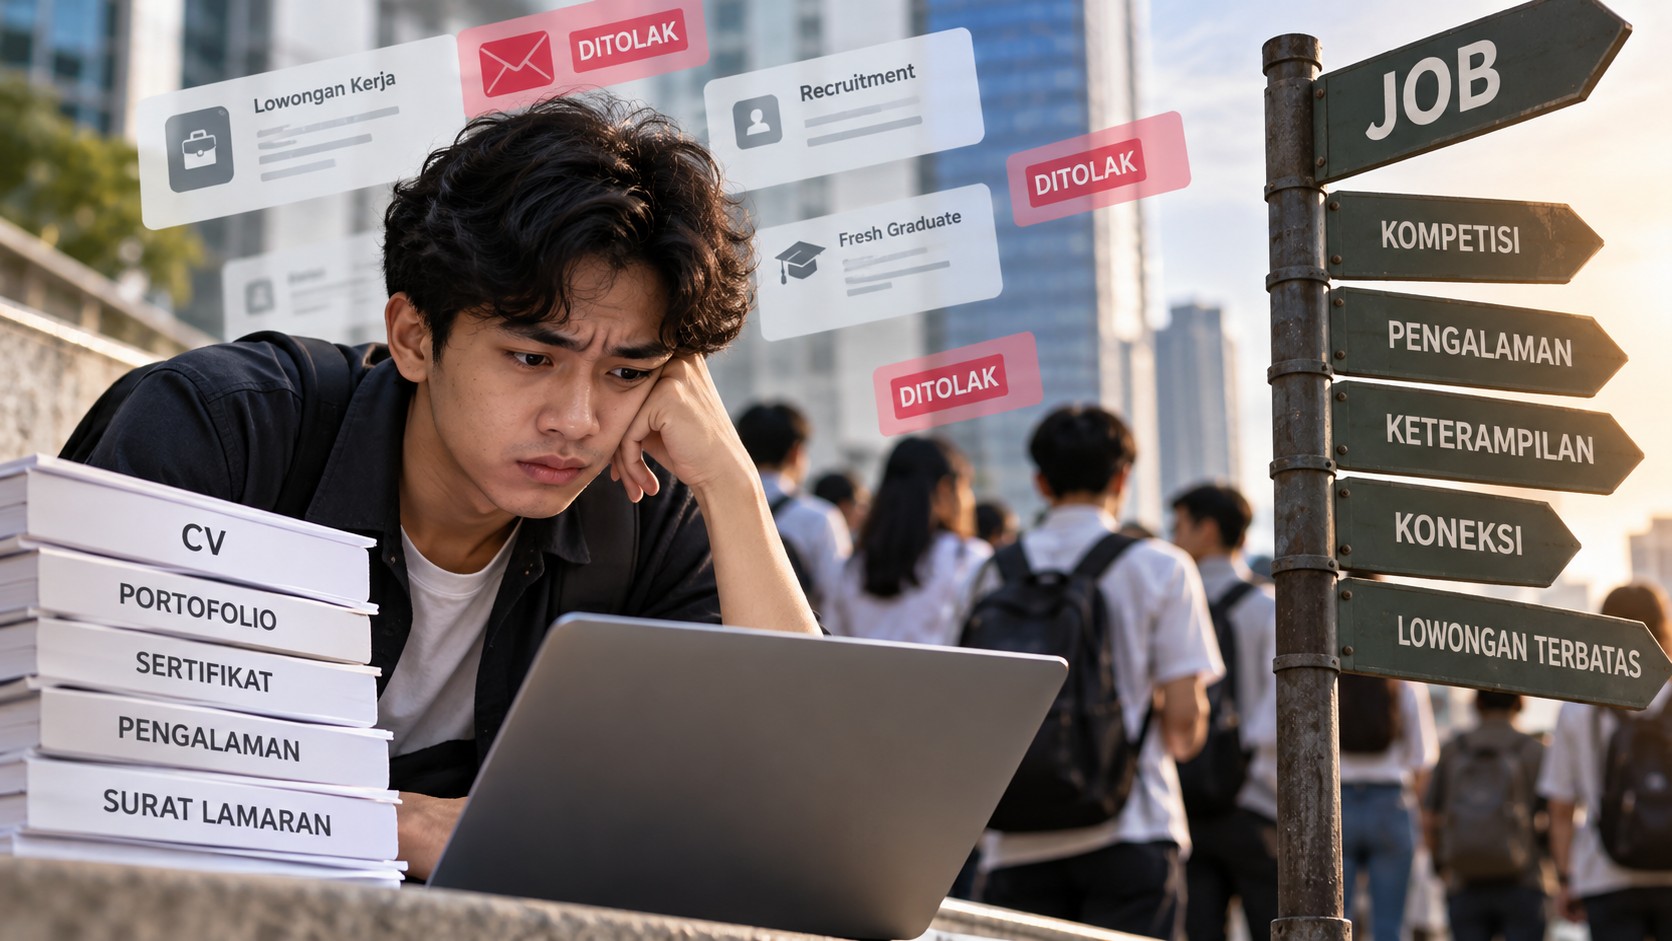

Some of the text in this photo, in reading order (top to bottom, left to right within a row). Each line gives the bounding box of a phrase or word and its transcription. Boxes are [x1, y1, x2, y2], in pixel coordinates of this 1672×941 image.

[1365, 39, 1501, 141] JOB
[1381, 220, 1520, 254] KOMPETISI
[1388, 319, 1572, 367] PENGALAMAN
[1386, 413, 1595, 465] KETERAMPILAN
[181, 523, 226, 556] CV
[1395, 512, 1523, 556] KONEKSI
[119, 582, 277, 631] PORTOFOLIO
[1397, 614, 1642, 679] LOWONGAN TERBATAS
[135, 651, 273, 693] SERTIFIKAT
[118, 716, 300, 762] PENGALAMAN
[103, 789, 331, 837] SURAT LAMARAN
